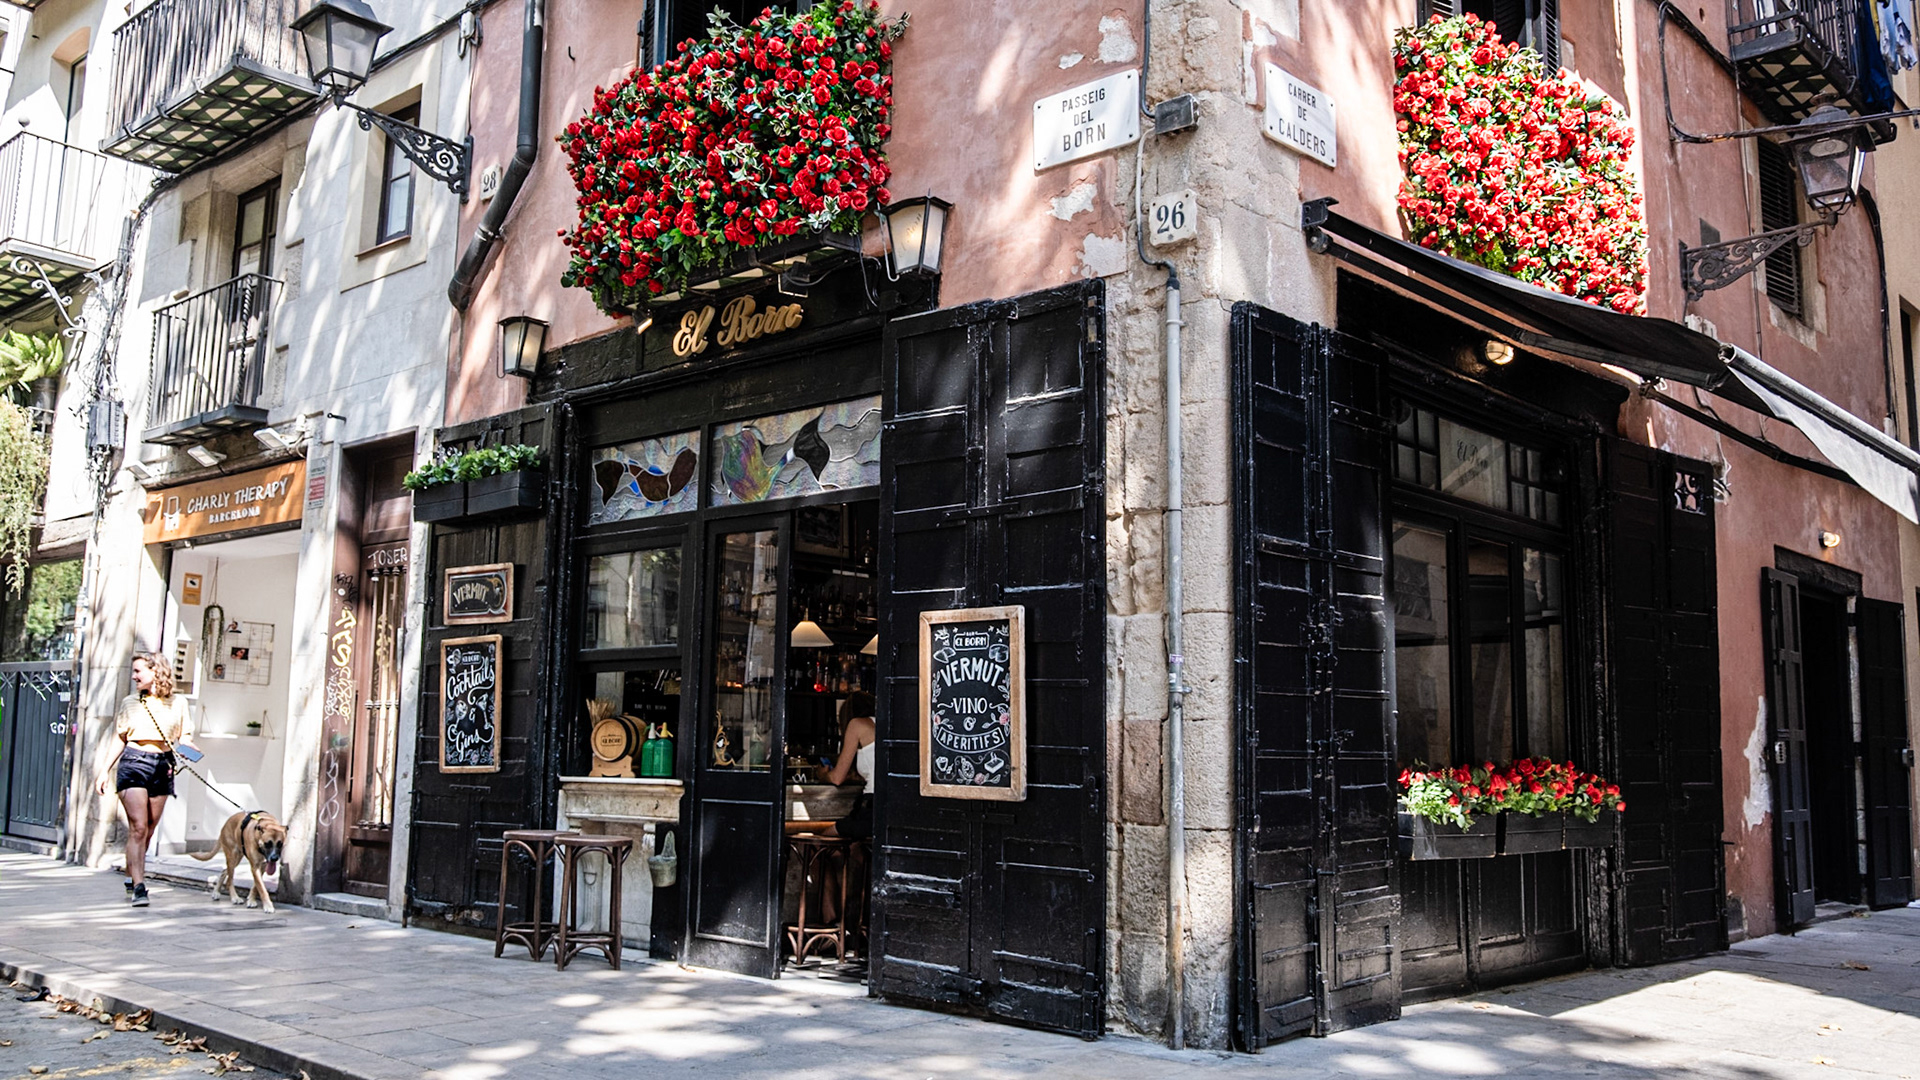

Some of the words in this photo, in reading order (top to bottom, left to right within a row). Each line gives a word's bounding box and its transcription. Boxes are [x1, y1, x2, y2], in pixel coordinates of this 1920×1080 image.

[1062, 88, 1106, 113] PASSEIG
[1288, 83, 1317, 108] CARRER
[1073, 109, 1094, 127] DEL
[1297, 105, 1307, 121] DE
[1063, 122, 1106, 152] BORN
[1279, 118, 1326, 157] CALDERS
[483, 171, 497, 193] 28
[1156, 200, 1185, 235] 26
[672, 304, 716, 357] El
[717, 294, 803, 346] Born
[187, 490, 232, 514] CHARLY
[234, 476, 289, 505] THERAPY
[208, 505, 261, 525] BARCELONA
[453, 583, 489, 604] VERMUT
[964, 636, 987, 647] BORN
[447, 656, 495, 700] Cocktails
[940, 657, 1004, 687] VERMUT
[953, 697, 988, 714] VINO
[456, 729, 481, 762] Gins
[941, 732, 1001, 750] APERITIFS
